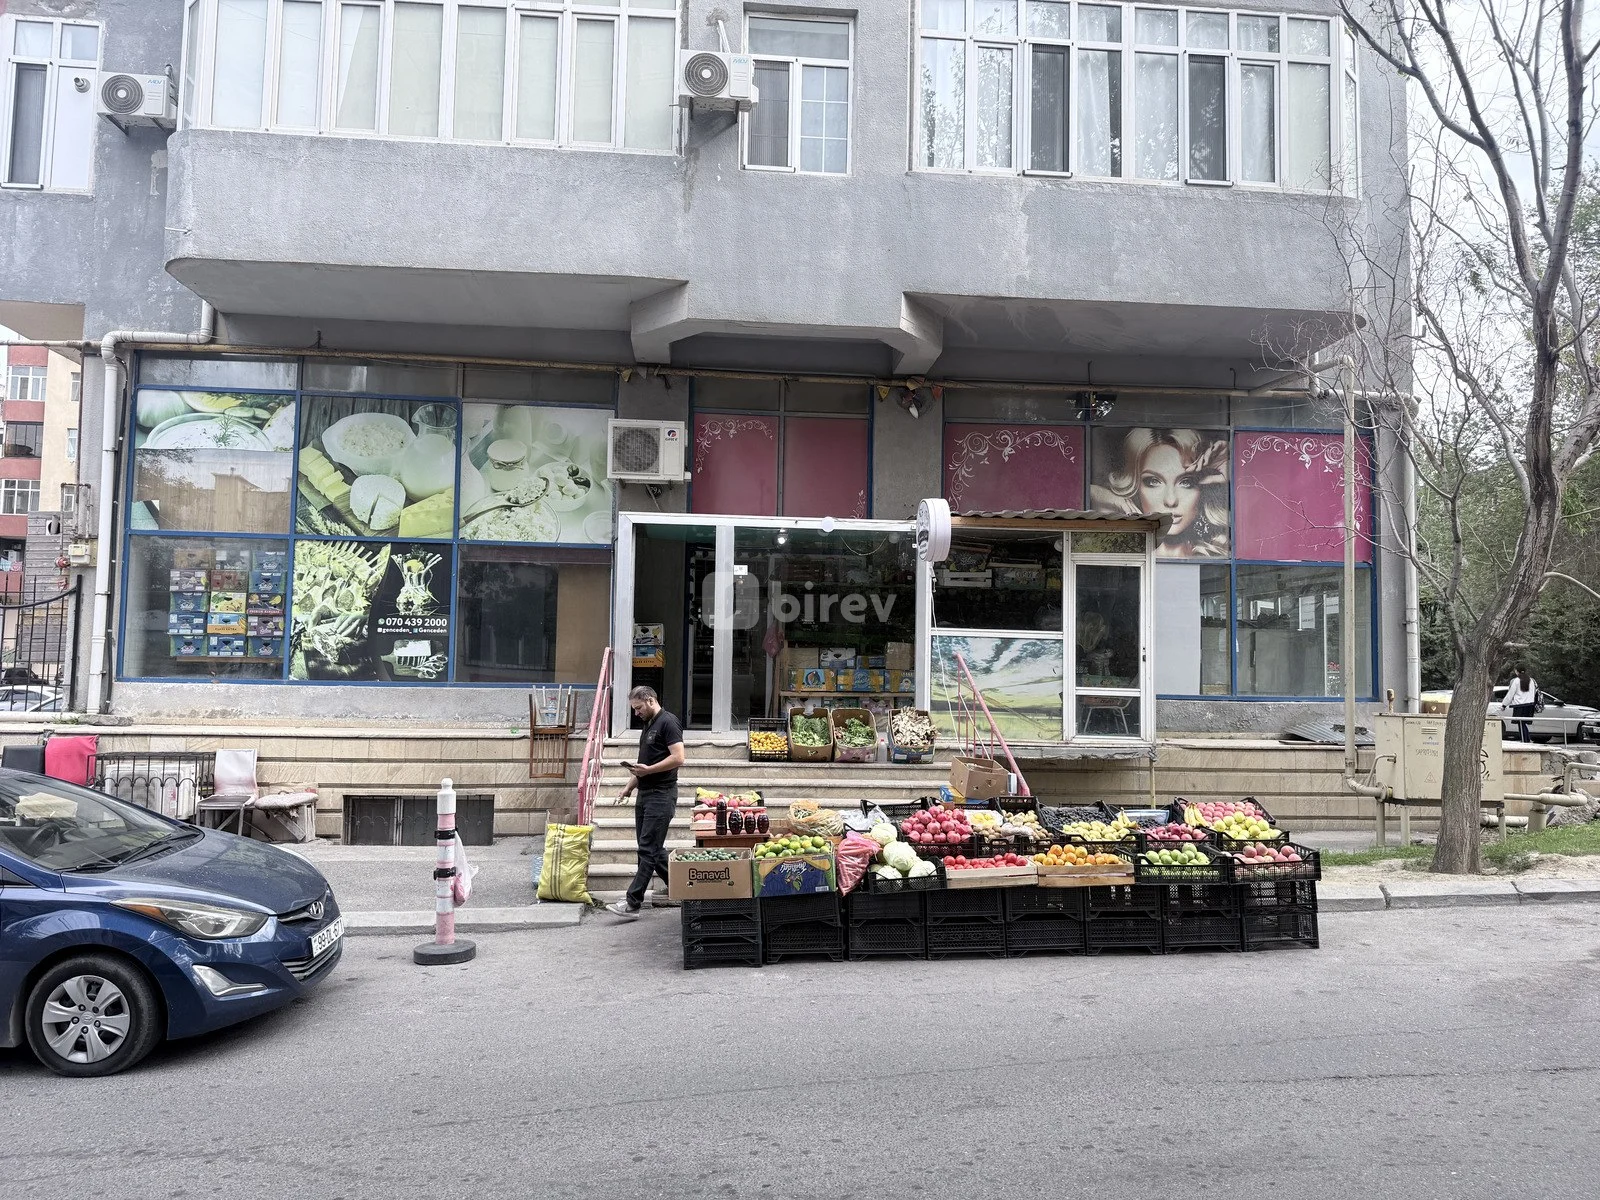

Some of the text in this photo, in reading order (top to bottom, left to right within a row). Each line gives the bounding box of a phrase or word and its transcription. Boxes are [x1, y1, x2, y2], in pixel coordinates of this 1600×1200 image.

[385, 617, 448, 627] 070 439 2000
[689, 867, 730, 880] Banaval
